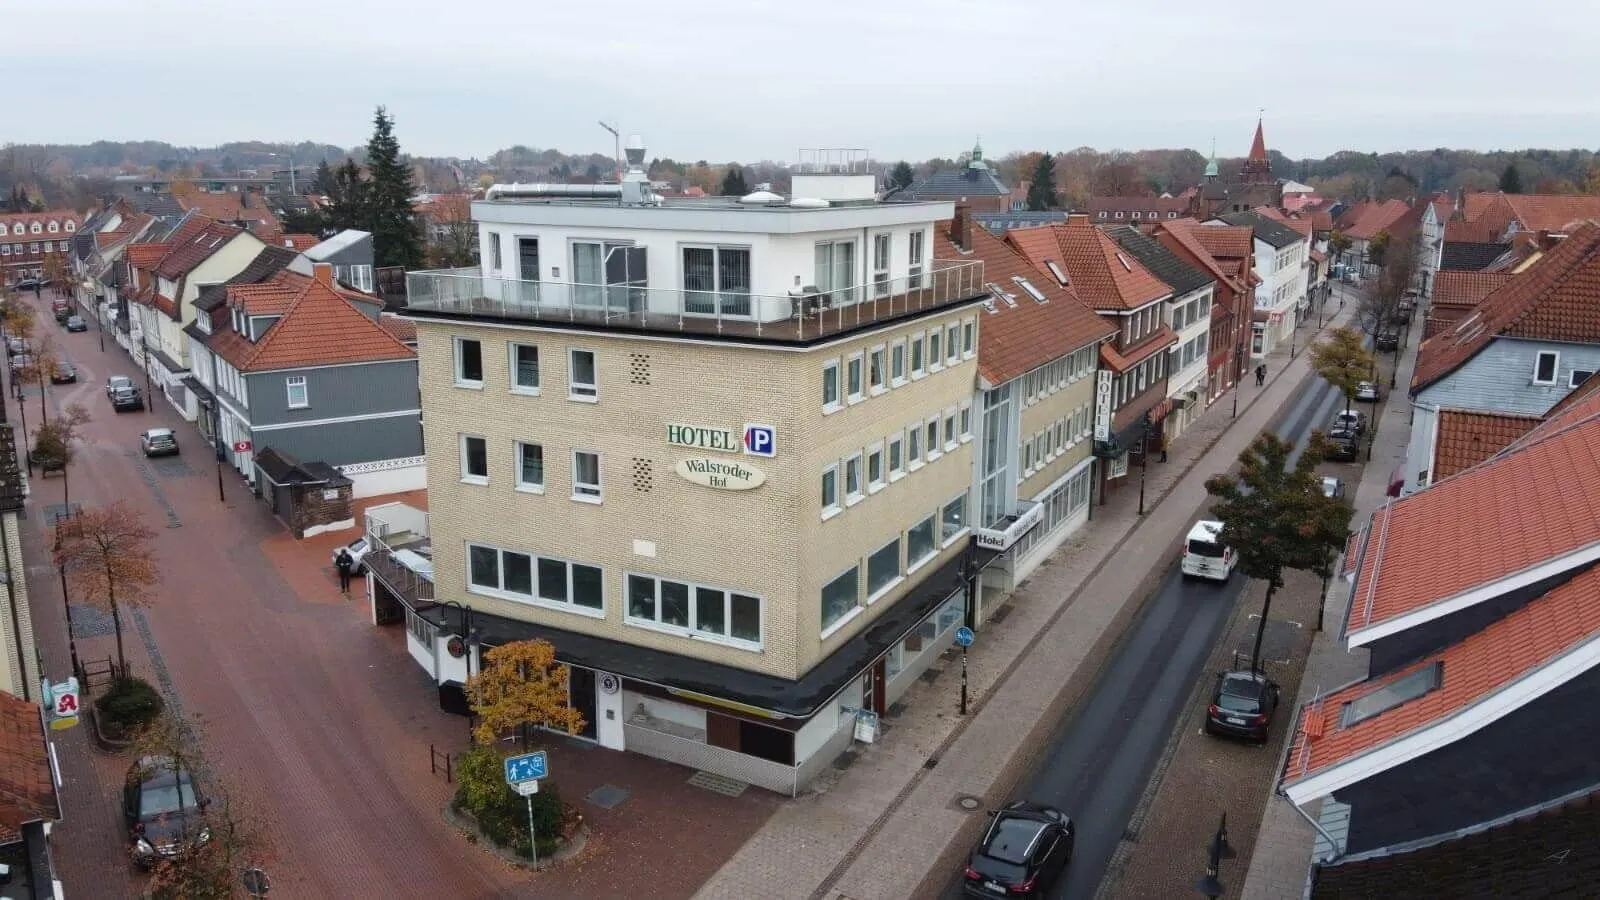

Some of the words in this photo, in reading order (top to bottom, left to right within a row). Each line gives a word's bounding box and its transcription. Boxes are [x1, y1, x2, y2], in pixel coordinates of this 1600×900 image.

[1097, 371, 1110, 425] HOTEL
[668, 425, 736, 450] HOTEL
[754, 430, 770, 451] P
[685, 459, 753, 480] Walsroder
[709, 476, 727, 487] Hof
[978, 534, 1004, 546] Hotel
